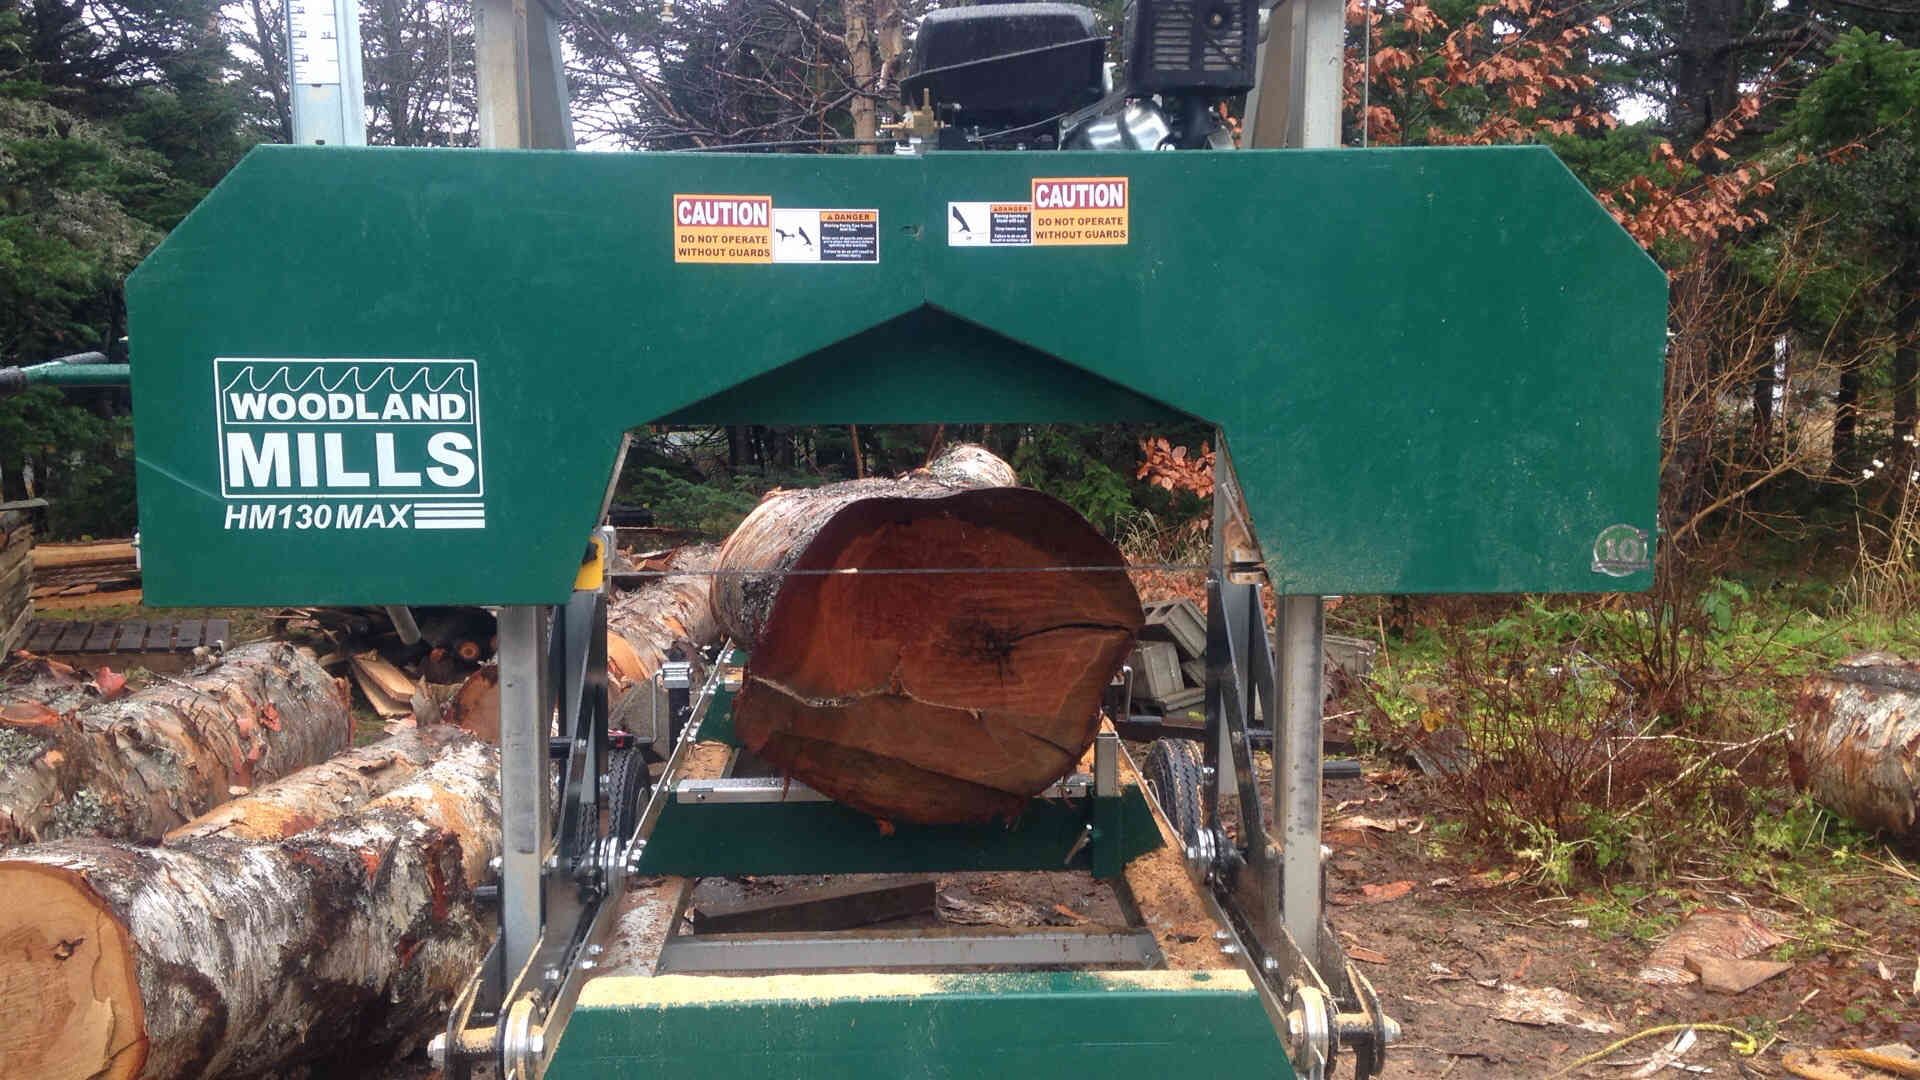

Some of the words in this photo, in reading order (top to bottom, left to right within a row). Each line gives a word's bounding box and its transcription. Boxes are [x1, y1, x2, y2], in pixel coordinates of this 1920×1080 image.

[1035, 183, 1123, 208] CAUTION
[678, 200, 768, 226] CAUTION
[1038, 217, 1052, 226] DO
[1054, 217, 1074, 226] NOT
[1077, 217, 1123, 226] OPERATE
[680, 234, 696, 244] DO
[698, 234, 719, 244] NOT
[722, 235, 769, 245] OPERATE
[1035, 230, 1083, 240] WITHOUT
[1085, 230, 1126, 239] GUARDS
[678, 247, 726, 257] WITHOUT
[728, 247, 770, 257] GUARDS
[230, 392, 466, 421] WOODLAND
[226, 431, 475, 488] MILLS
